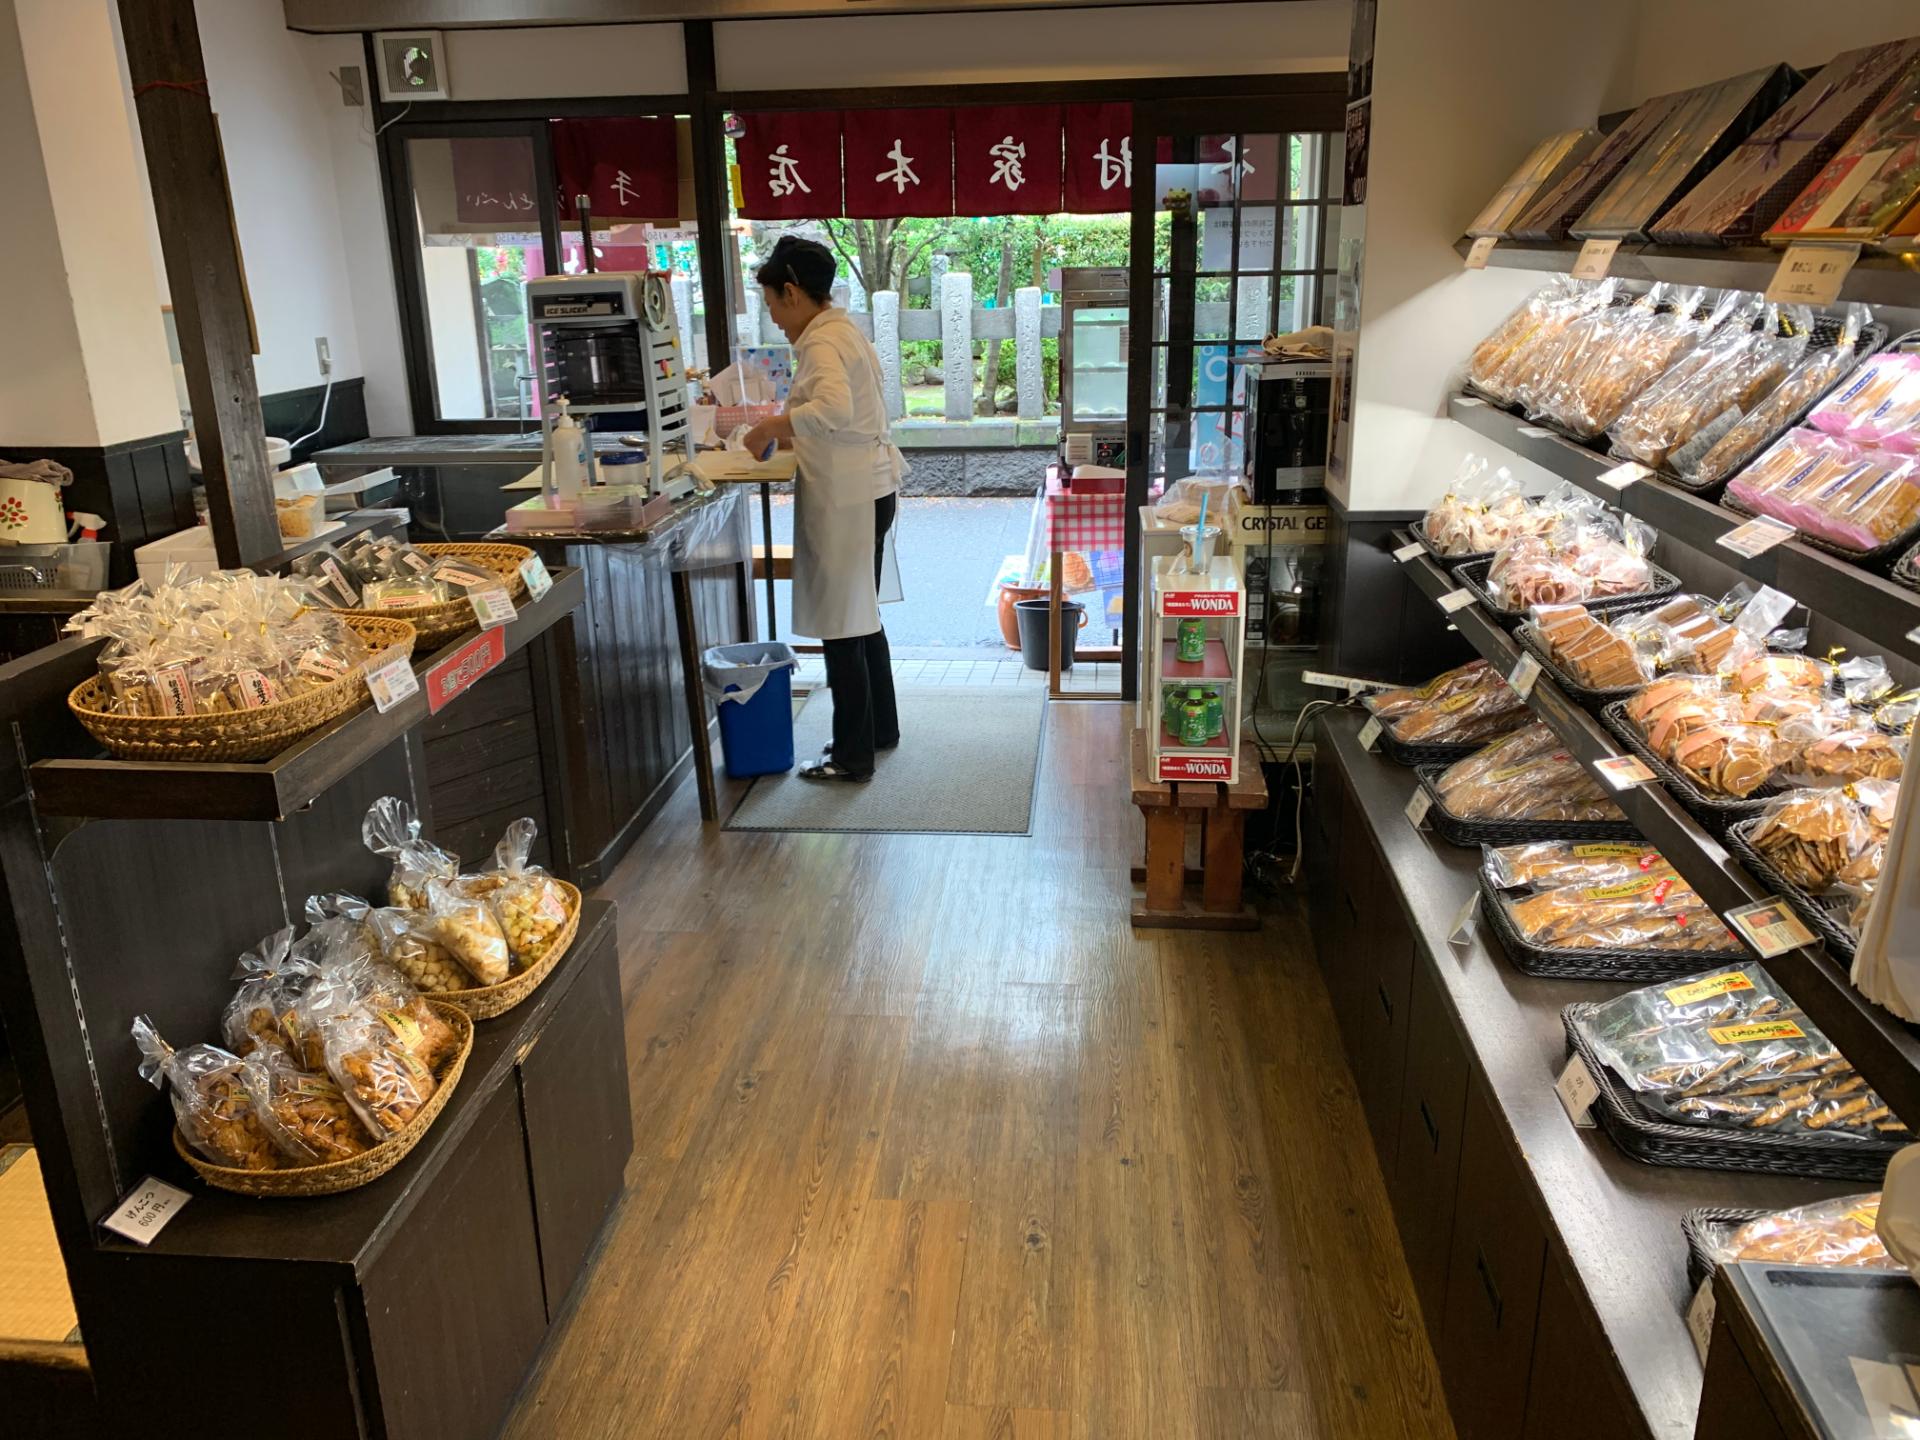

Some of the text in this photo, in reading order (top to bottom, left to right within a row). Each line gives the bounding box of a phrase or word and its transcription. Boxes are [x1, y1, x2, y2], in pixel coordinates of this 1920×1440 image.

[1242, 516, 1329, 531] CRYSTAL GE
[1190, 598, 1234, 611] WONDA
[1185, 763, 1228, 776] WONDA
